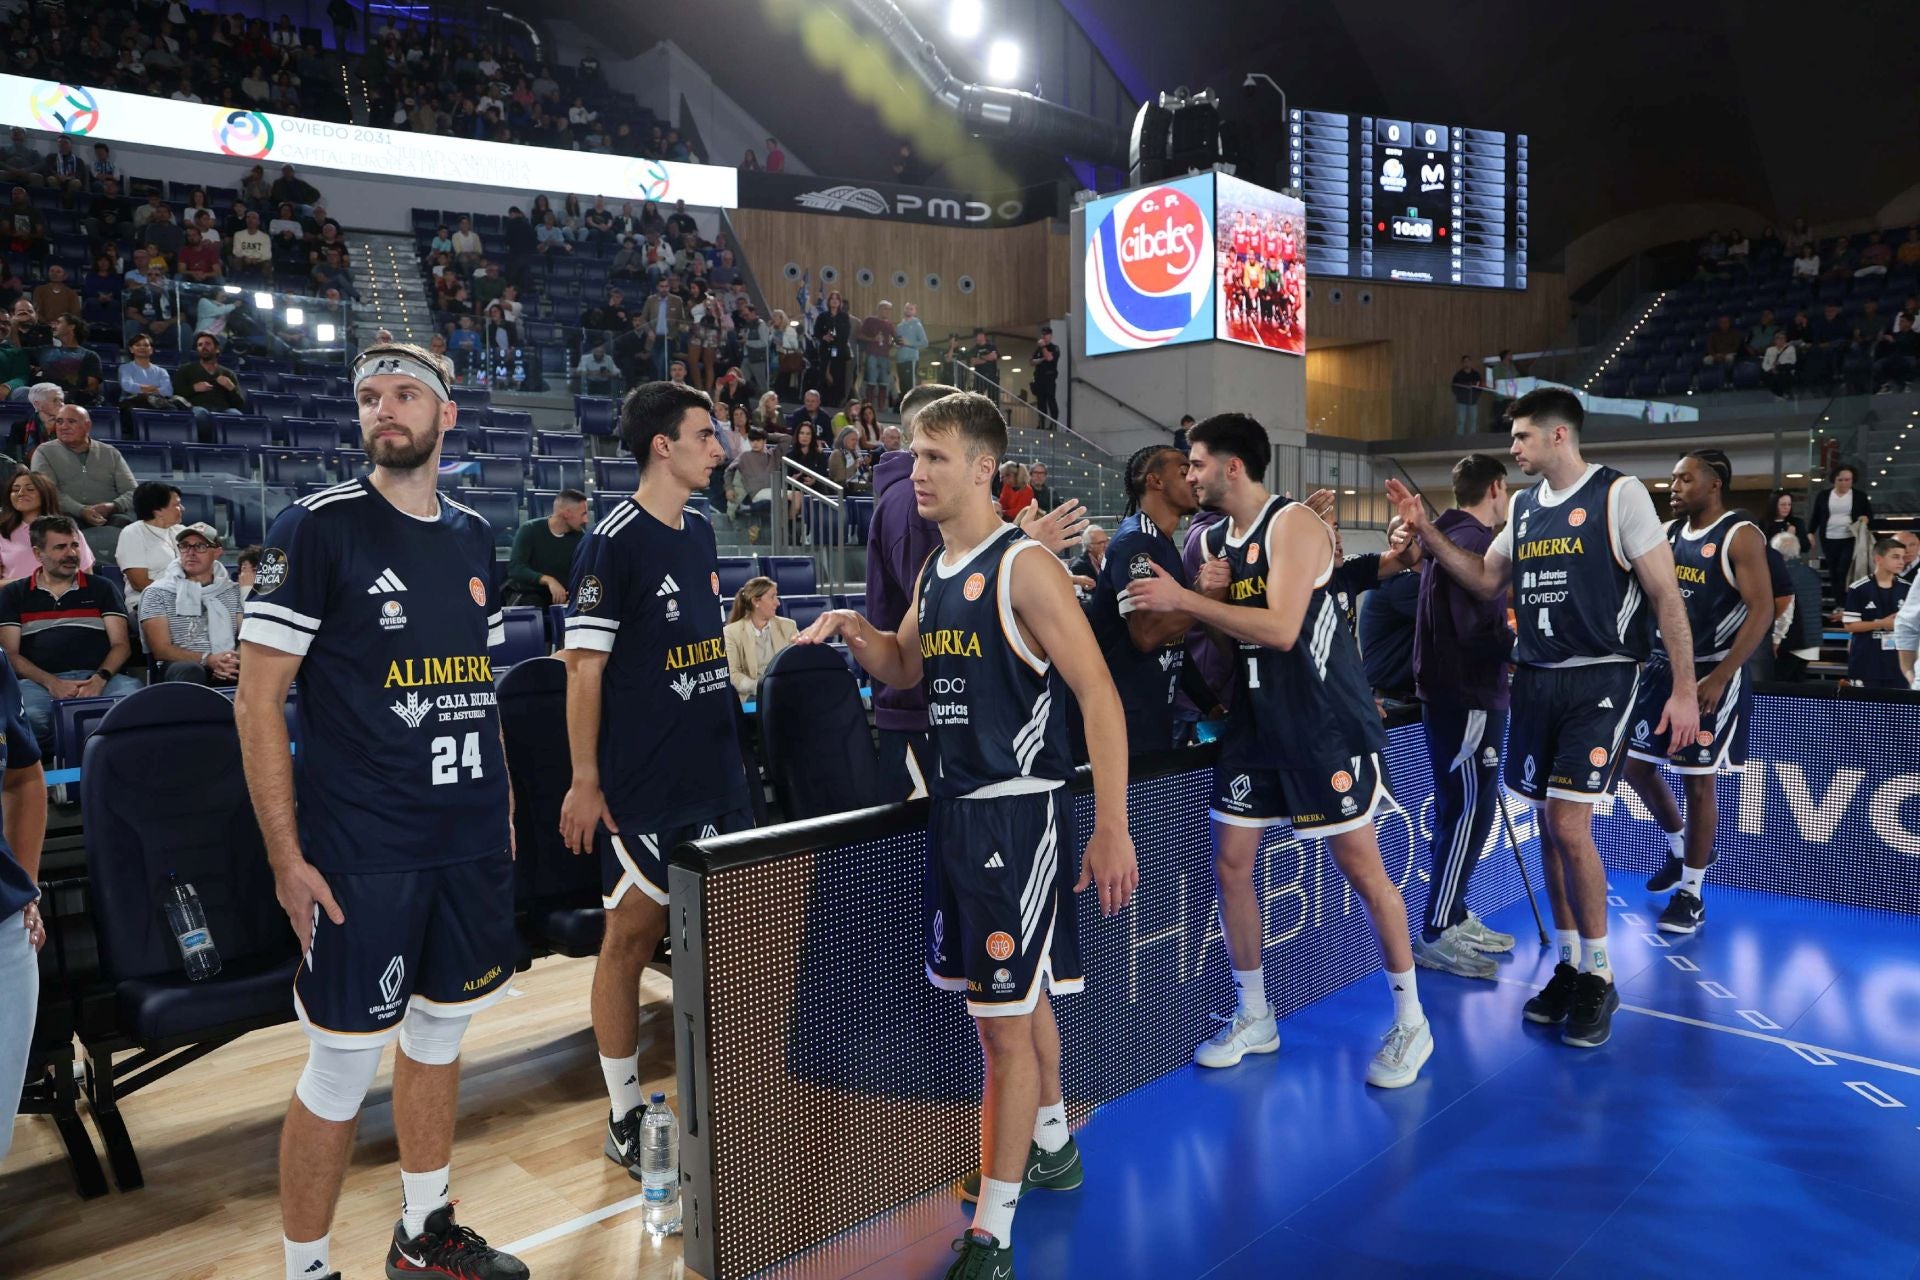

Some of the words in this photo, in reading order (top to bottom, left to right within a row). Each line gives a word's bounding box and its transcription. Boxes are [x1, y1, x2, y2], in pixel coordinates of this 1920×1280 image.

[280, 119, 349, 140] OVIEDO
[353, 129, 392, 145] 2031
[1388, 125, 1400, 142] 0
[1425, 129, 1437, 146] 0
[1393, 221, 1432, 238] 10:00
[1121, 215, 1196, 276] cibeles
[1528, 591, 1566, 604] OVIEDO
[380, 616, 407, 626] OVIEDO
[1538, 607, 1554, 637] 4
[383, 656, 494, 688] ALIMERK
[1247, 657, 1261, 689] 1
[436, 694, 468, 708] CAJA
[438, 713, 452, 722] DE
[431, 731, 484, 785] 24
[1292, 814, 1325, 824] LIMERKA
[463, 965, 502, 991] ALIMERKA
[992, 982, 1016, 990] OVIEDO
[369, 1005, 385, 1014] URIA
